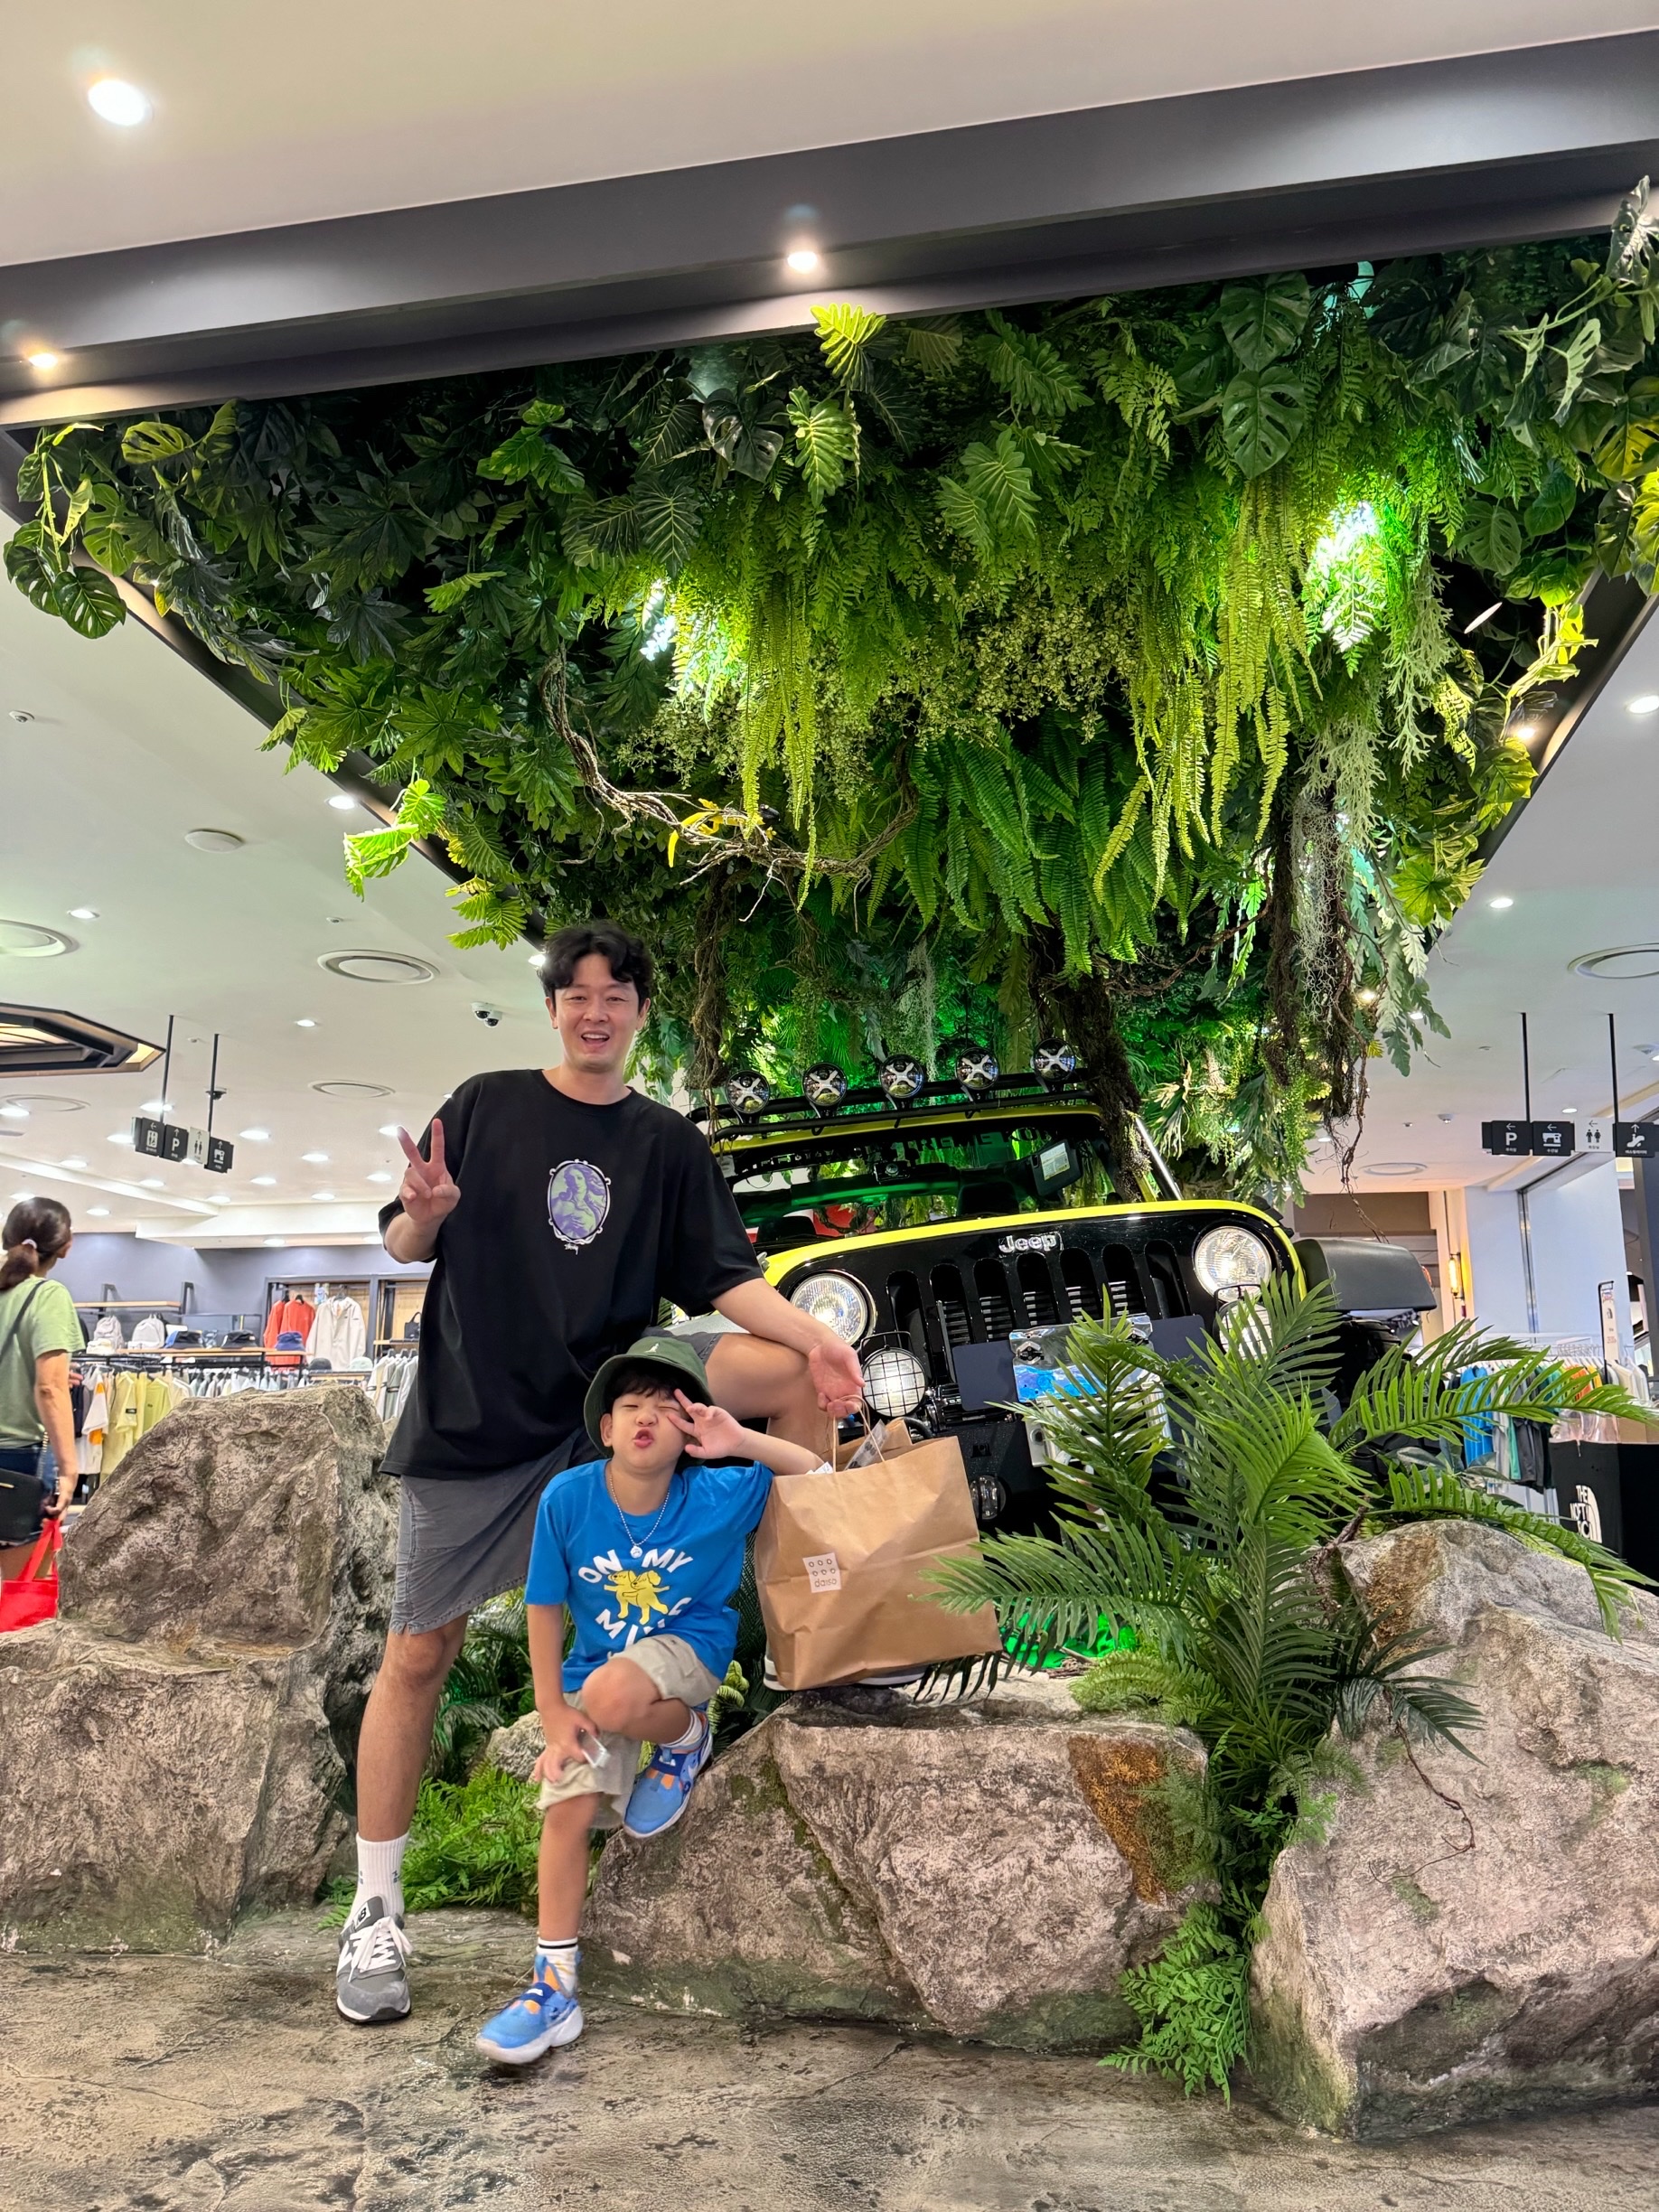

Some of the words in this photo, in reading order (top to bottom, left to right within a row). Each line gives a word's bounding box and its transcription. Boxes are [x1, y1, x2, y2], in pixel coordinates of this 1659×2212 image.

[172, 1138, 180, 1151] P
[1505, 1132, 1517, 1146] P
[998, 1235, 1057, 1253] Jeep
[577, 1549, 623, 1583] ON
[642, 1548, 694, 1573] MY
[814, 1578, 838, 1588] daiso
